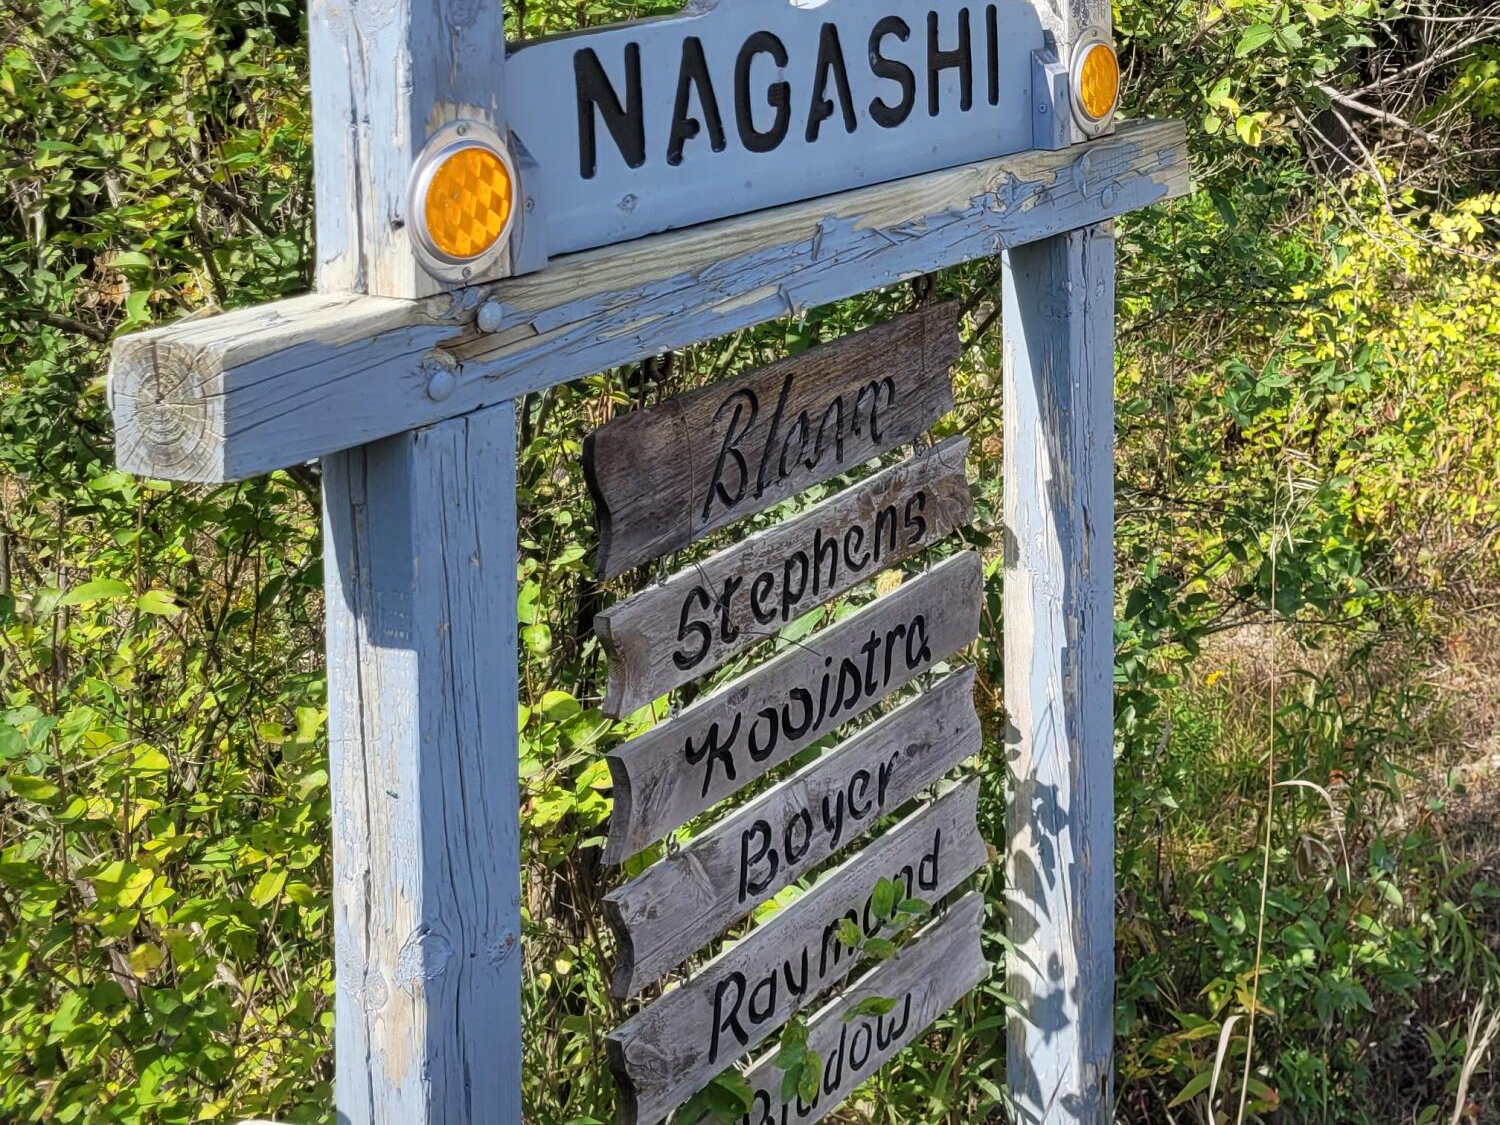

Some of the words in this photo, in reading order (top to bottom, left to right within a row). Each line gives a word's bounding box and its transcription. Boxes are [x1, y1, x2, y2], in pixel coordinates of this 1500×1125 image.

[573, 3, 999, 180] NAGASHI
[672, 490, 926, 671] Stephens
[684, 614, 932, 799] Kooistra
[738, 750, 900, 904] Boyer
